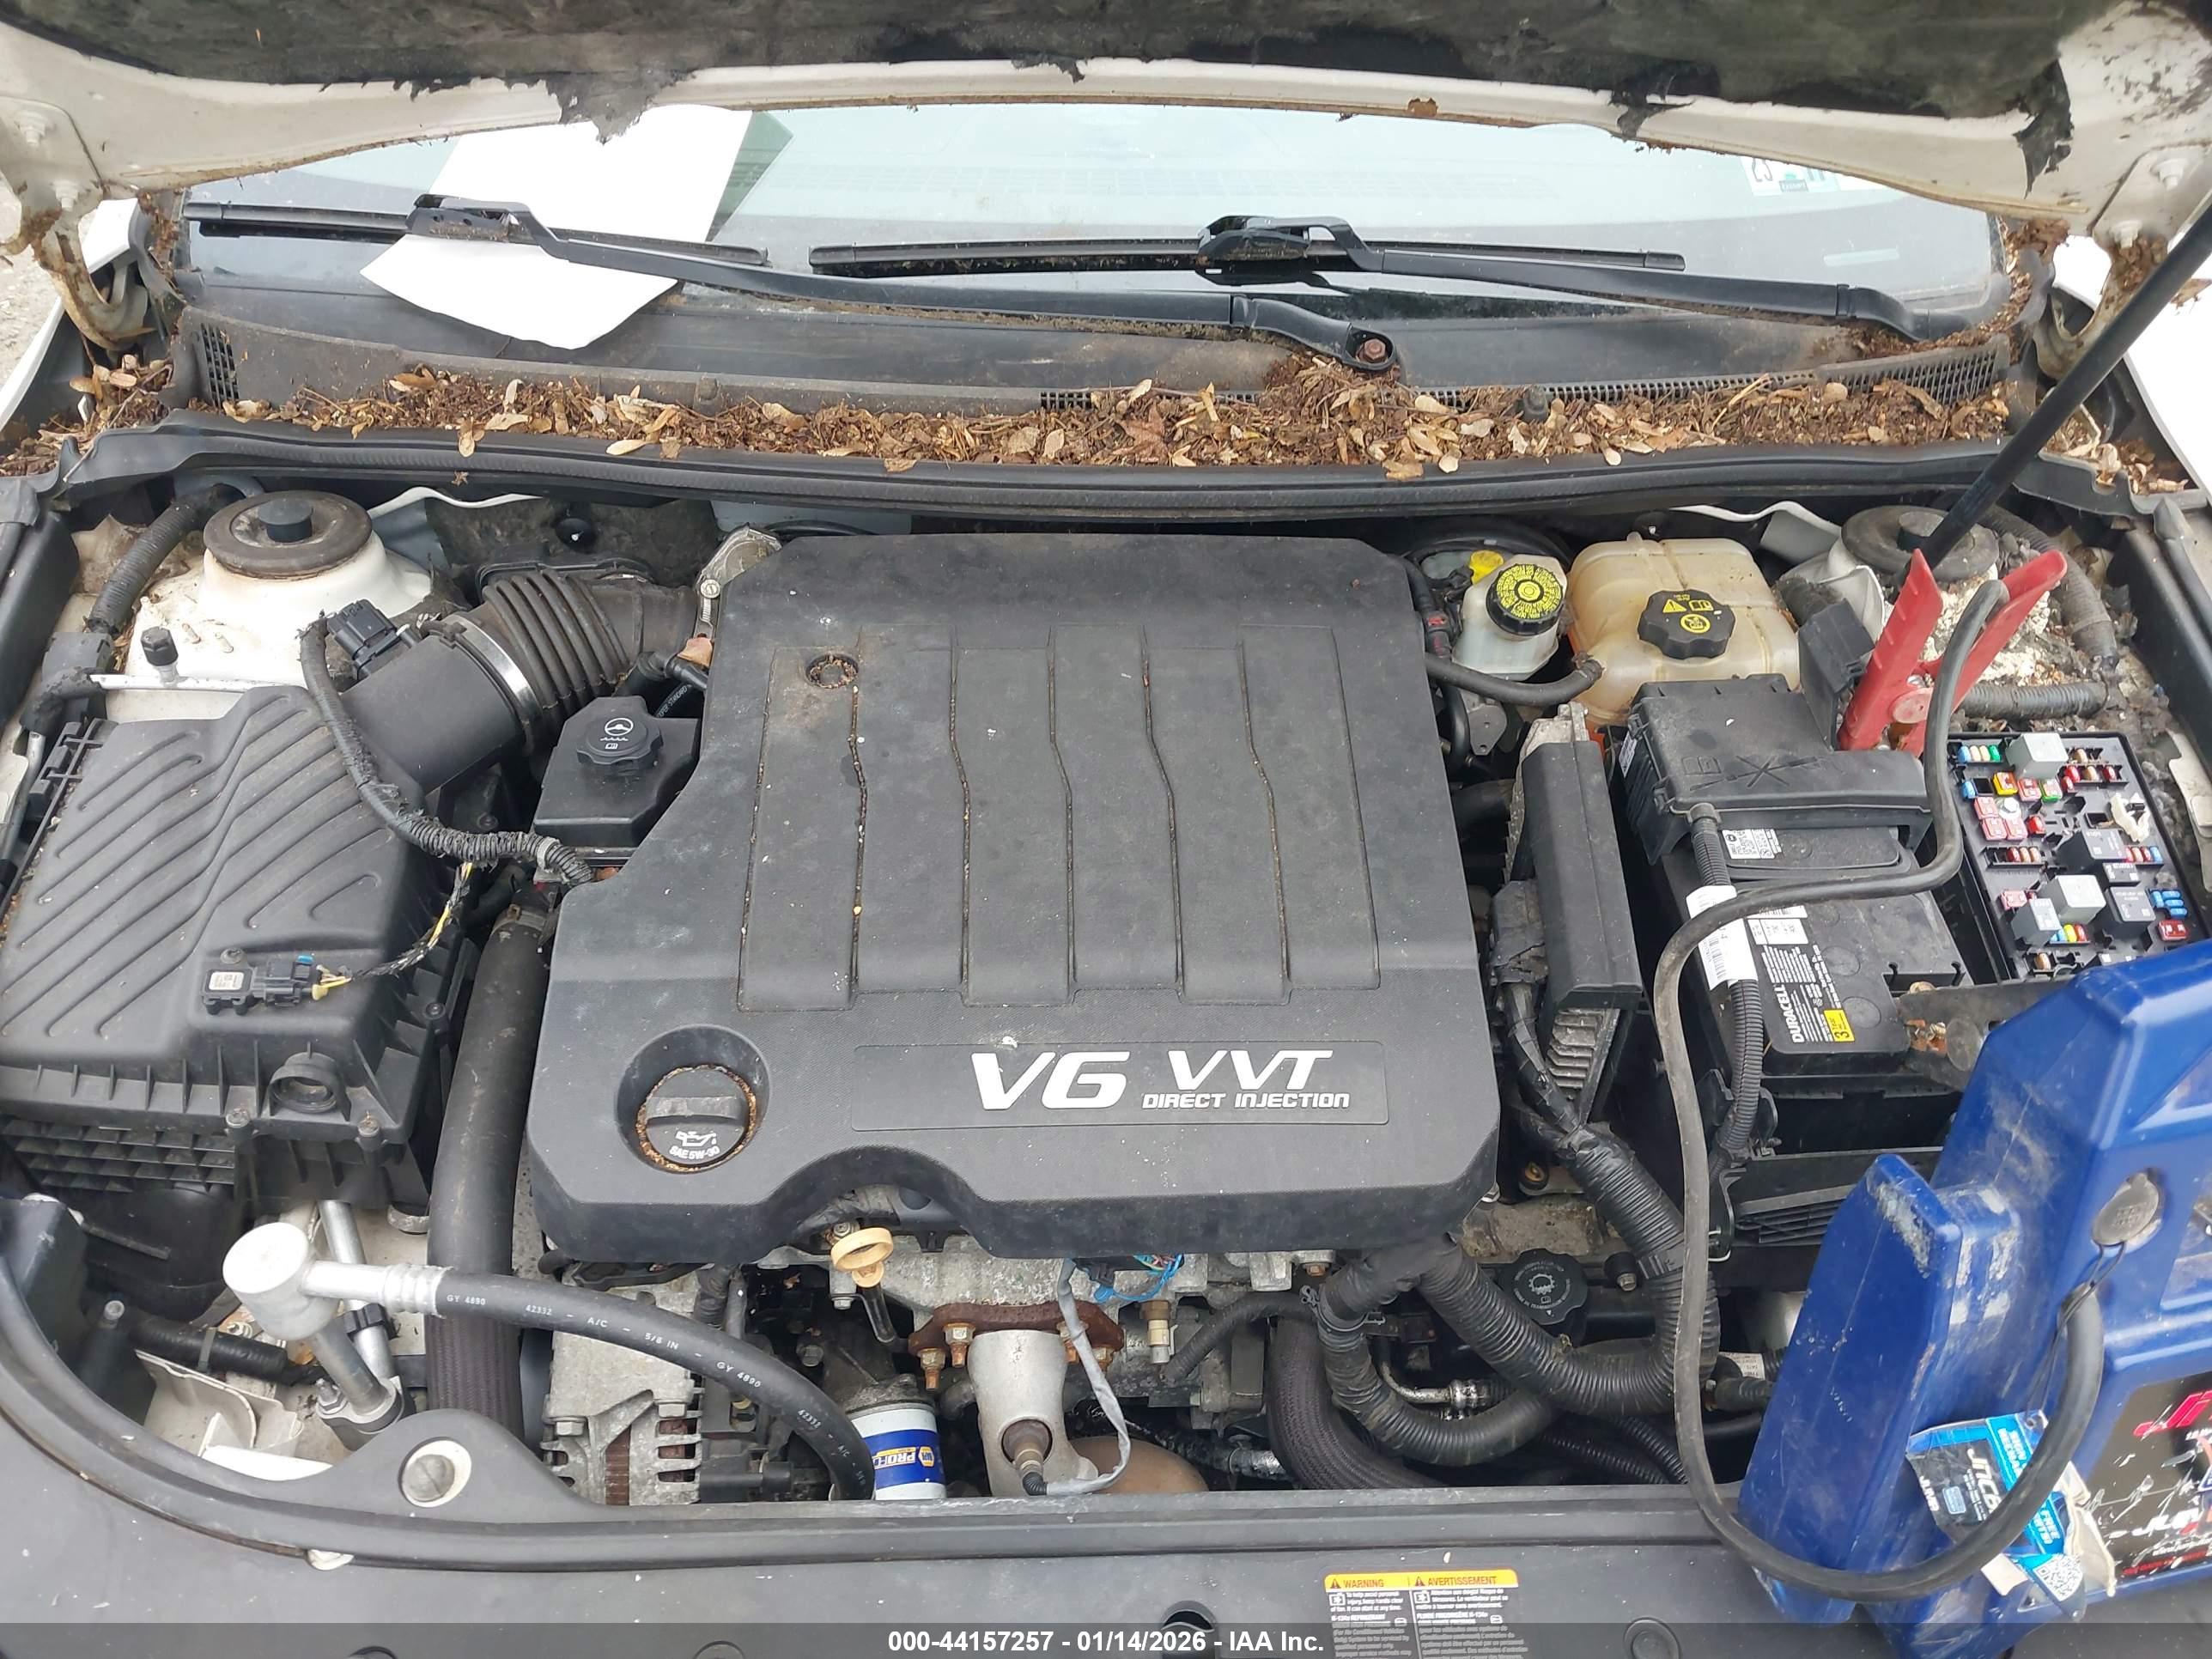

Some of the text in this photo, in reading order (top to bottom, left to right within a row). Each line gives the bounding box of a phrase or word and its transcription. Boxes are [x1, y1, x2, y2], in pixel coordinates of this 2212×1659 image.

[1774, 984, 1805, 1043] DURACELL
[1834, 1030, 1850, 1039] 3
[971, 1049, 1334, 1110] V6 VVT
[1142, 1092, 1350, 1109] DIRECT INJECTION
[670, 1146, 720, 1159] SAE 5W-30
[447, 1294, 460, 1303] GY
[526, 1304, 553, 1316] 42332
[587, 1316, 608, 1328] A/C
[666, 1340, 679, 1350] IN
[716, 1361, 734, 1372] GY
[737, 1372, 762, 1389] 4890
[1343, 1578, 1384, 1588] WARNING
[1427, 1576, 1497, 1587] AVERTISSEMENT
